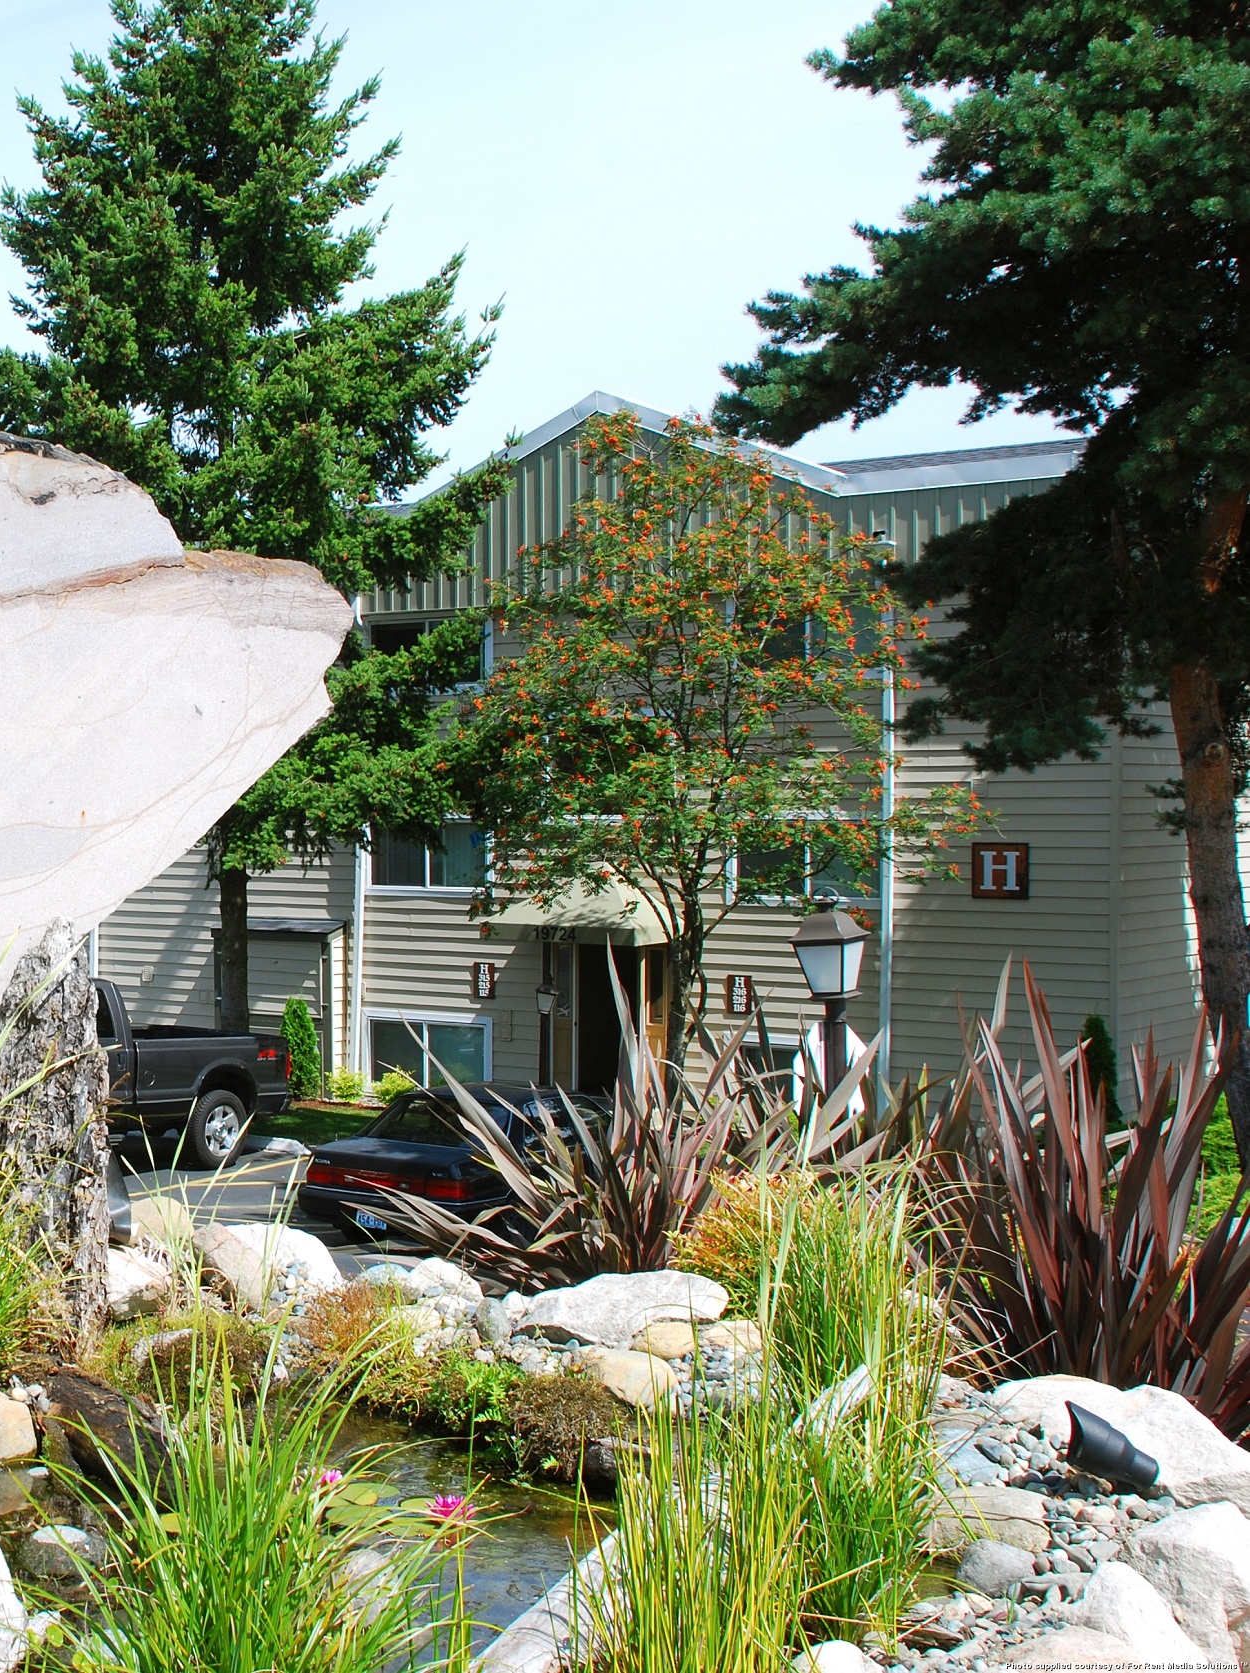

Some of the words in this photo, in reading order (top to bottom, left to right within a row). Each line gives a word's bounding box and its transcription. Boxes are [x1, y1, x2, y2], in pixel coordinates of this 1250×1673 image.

[979, 850, 1020, 891] H
[533, 926, 577, 941] 19724
[480, 964, 489, 974] H
[734, 976, 745, 987] H
[732, 987, 747, 996] 316
[732, 995, 747, 1004] 216
[733, 1004, 746, 1012] 116
